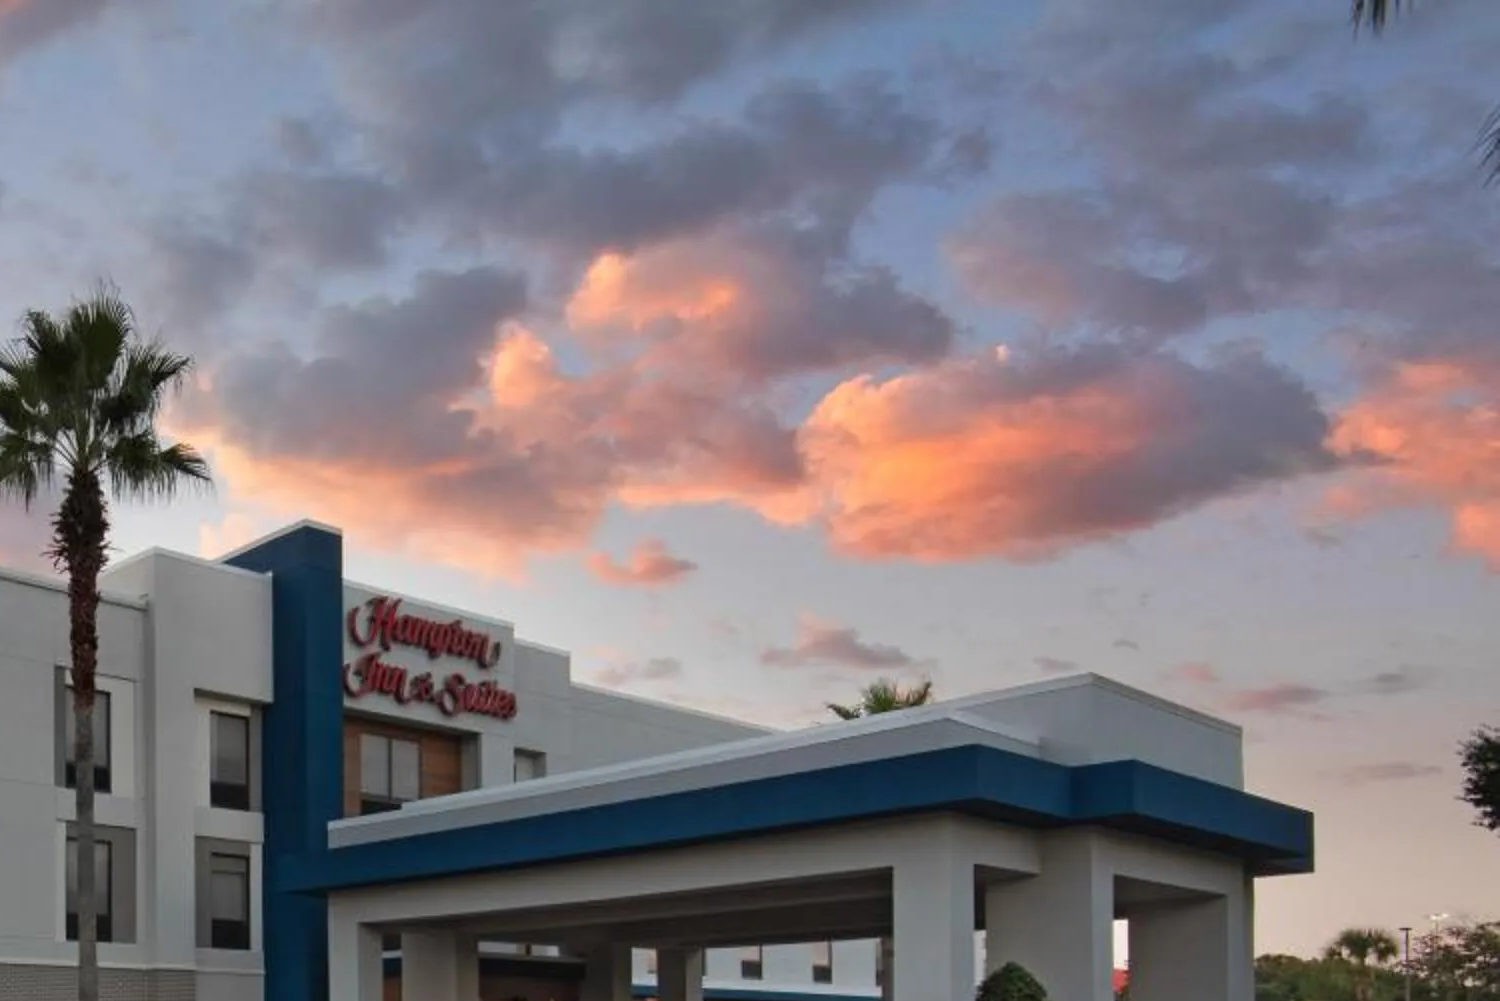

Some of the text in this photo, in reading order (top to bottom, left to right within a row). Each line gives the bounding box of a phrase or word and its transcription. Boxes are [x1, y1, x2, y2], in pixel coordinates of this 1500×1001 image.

[347, 596, 501, 669] Hampton
[342, 651, 517, 720] Inn & Suites
